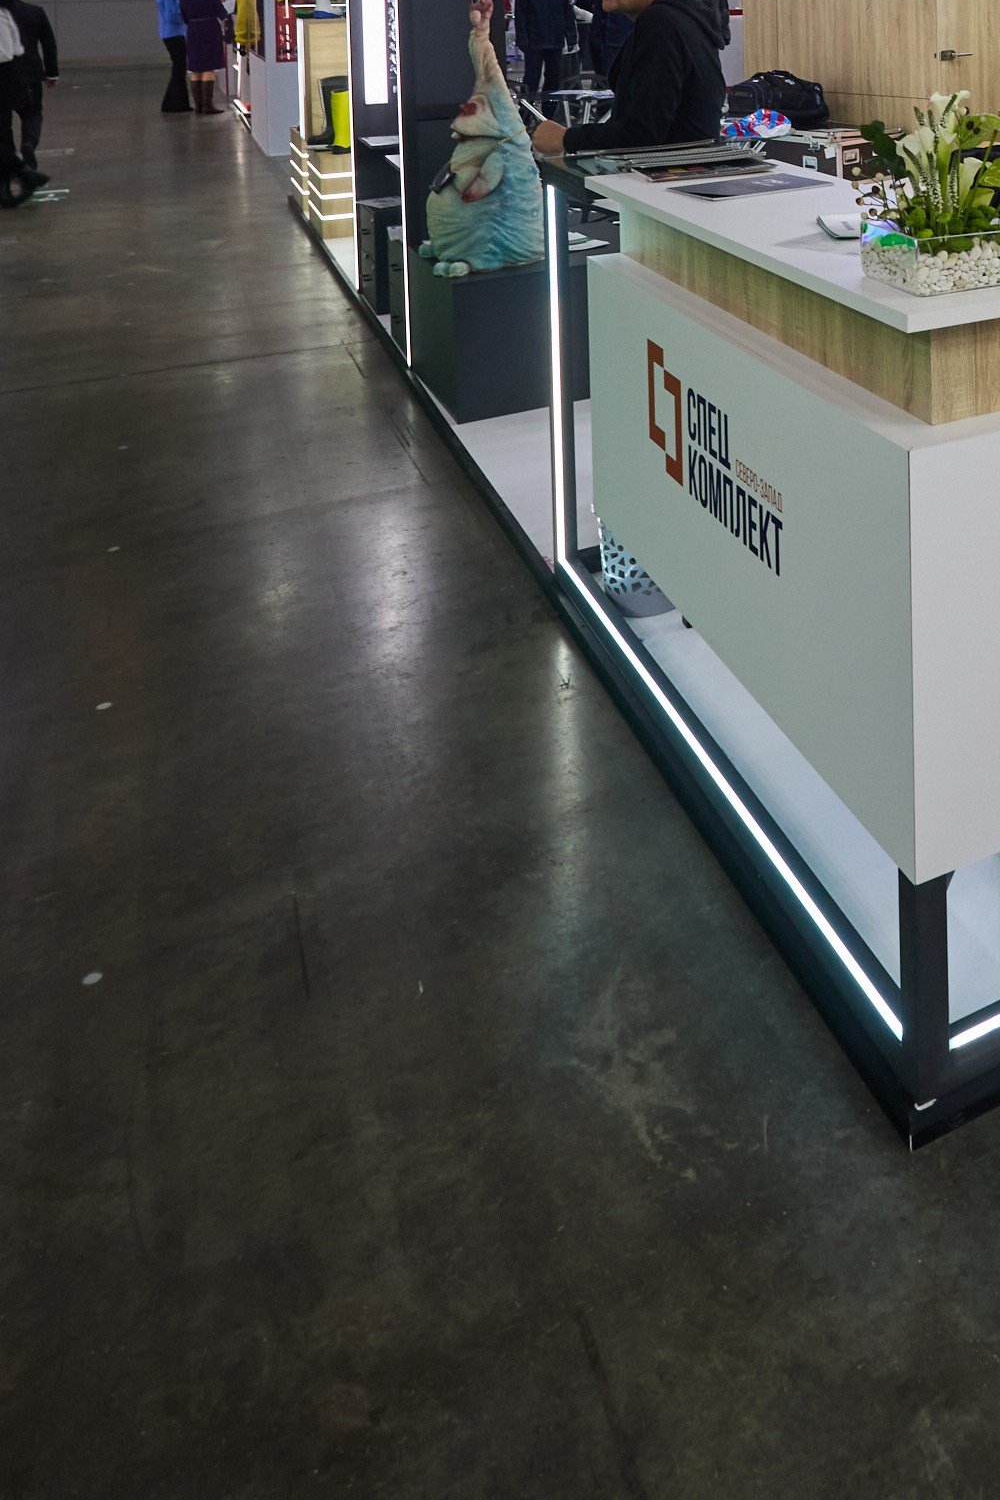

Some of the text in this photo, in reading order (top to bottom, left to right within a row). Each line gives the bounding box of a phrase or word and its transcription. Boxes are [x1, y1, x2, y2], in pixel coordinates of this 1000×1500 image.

[687, 388, 731, 470] СПЕЦ
[688, 444, 783, 577] КОМПЛЕКТ
[735, 459, 783, 513] СЕВЕРО-ЗАПАД
